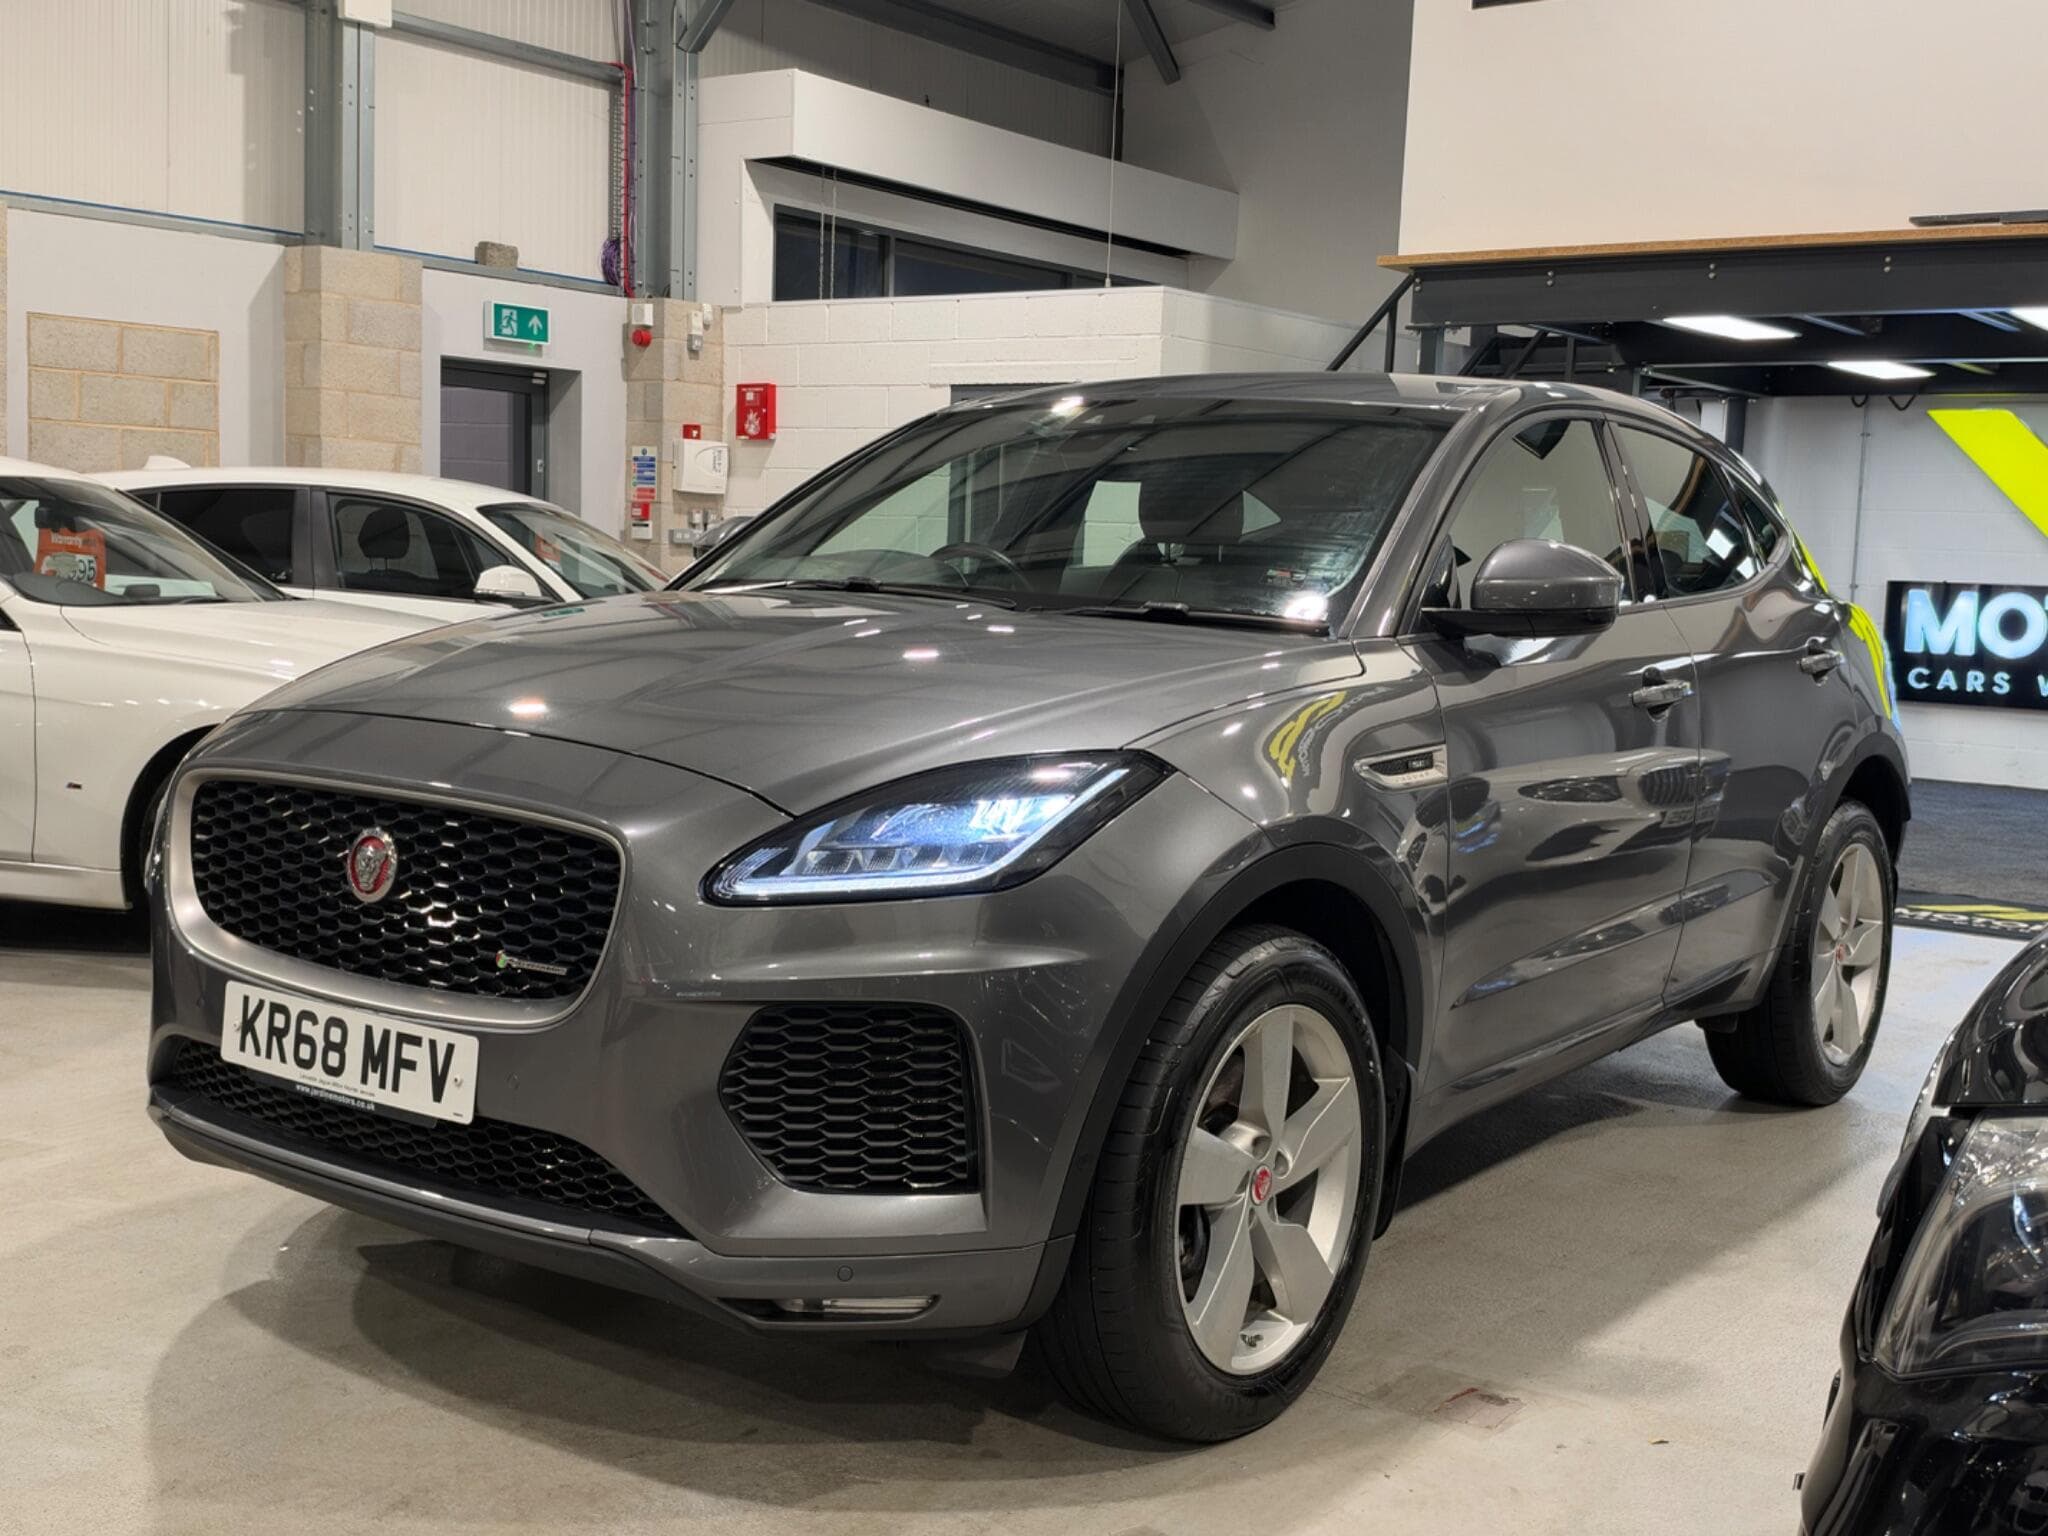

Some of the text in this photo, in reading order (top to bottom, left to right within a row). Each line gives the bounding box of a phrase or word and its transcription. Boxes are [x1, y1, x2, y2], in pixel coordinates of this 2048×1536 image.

[1904, 588, 2048, 660] MO
[1907, 667, 2011, 695] CARS
[239, 994, 456, 1104] KR68 MFV
